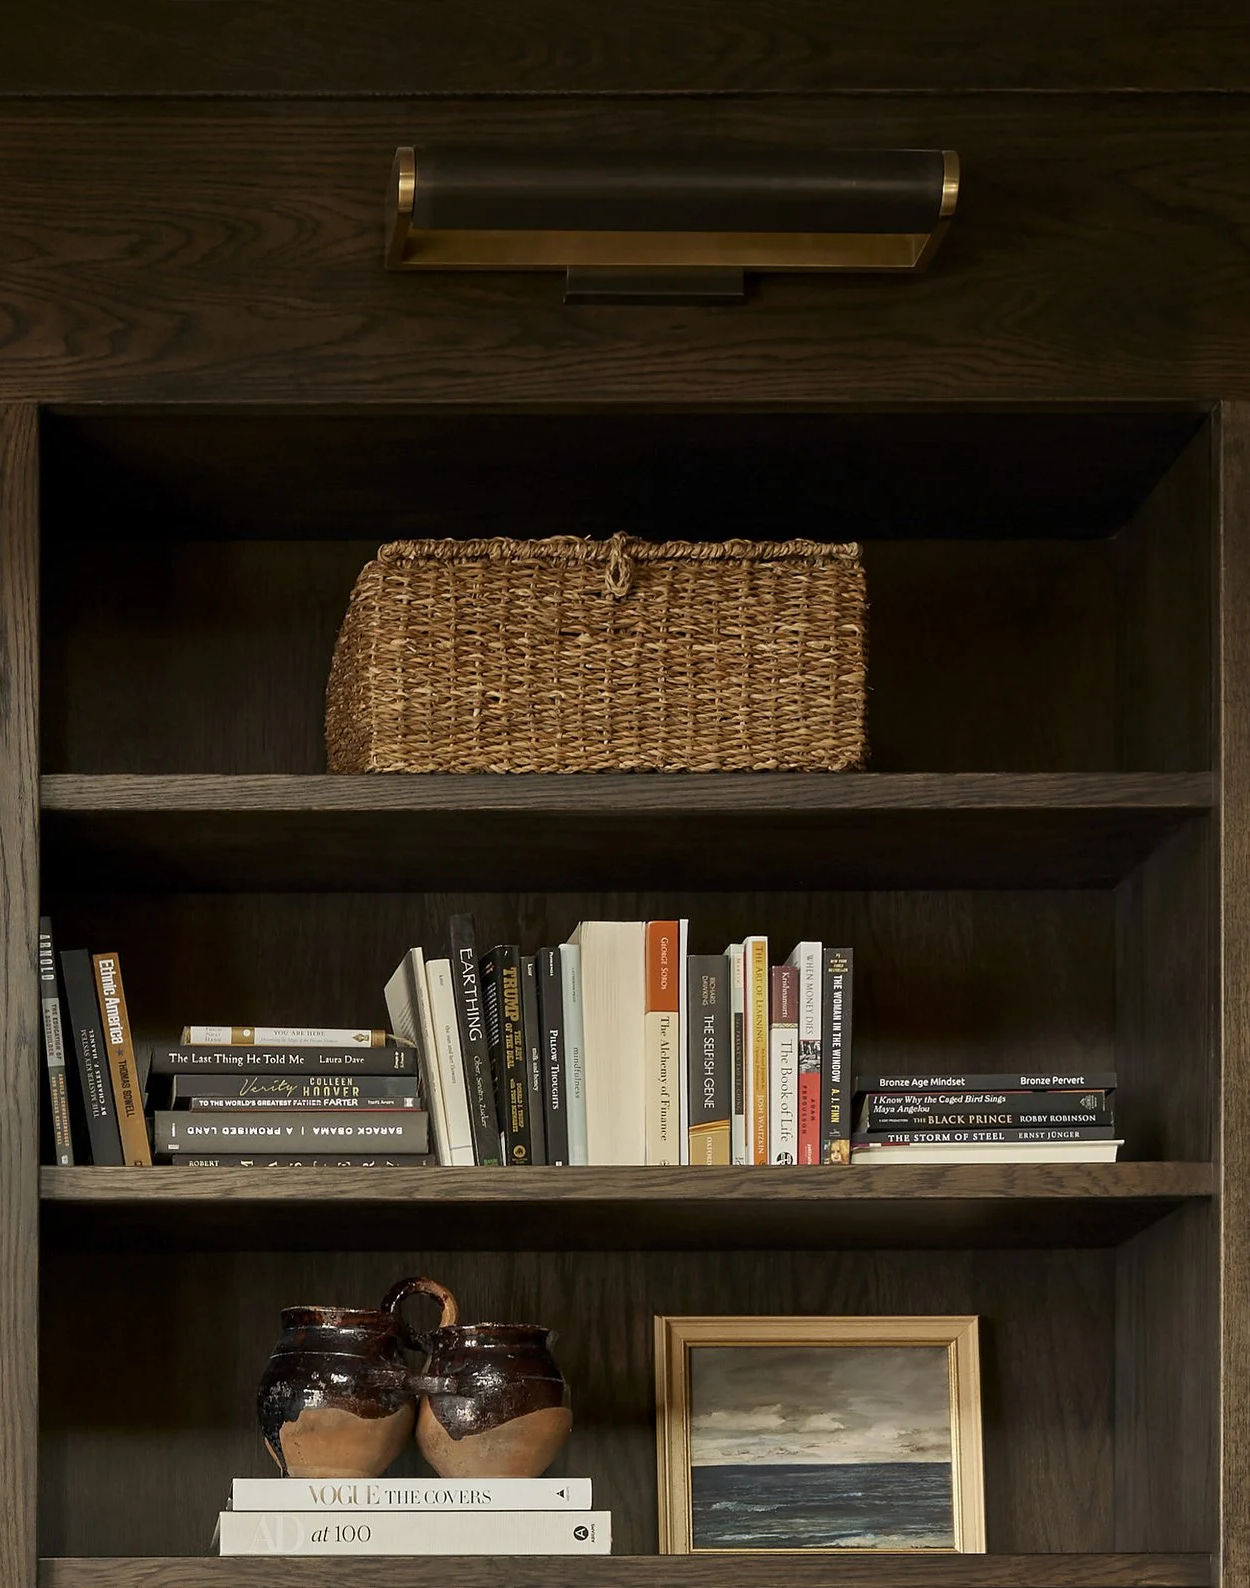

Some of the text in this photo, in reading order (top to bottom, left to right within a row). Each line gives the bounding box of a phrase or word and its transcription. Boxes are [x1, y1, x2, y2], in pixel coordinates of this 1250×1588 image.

[830, 974, 843, 990] THE
[98, 958, 124, 1046] Ethnic America
[459, 947, 484, 1042] EARTHING
[502, 966, 520, 1022] TRUMP
[830, 990, 843, 1021] WOMAN
[830, 1021, 843, 1032] IN
[830, 1032, 843, 1048] THE
[168, 1052, 305, 1067] The Last Thing He Told Me
[703, 1014, 716, 1109] THE SELFISH GENE
[830, 1048, 843, 1083] WINDOW
[308, 1077, 353, 1087] COLLEEN
[572, 1047, 582, 1100] mindfulness
[659, 1015, 671, 1142] The Alchemy of Finance
[879, 1077, 966, 1089] Bronze Age Mindset
[1019, 1076, 1085, 1086] Bronze Pervert
[238, 1076, 299, 1098] Verity
[780, 1038, 793, 1143] The Book of Life
[872, 1104, 931, 1115] Maya Angelou
[1019, 1114, 1097, 1123] ROBBY ROBINSON
[312, 1125, 404, 1136] BARACK OBAMA
[887, 1131, 1006, 1143] THE STORM OF STEEL
[307, 1483, 493, 1506] VOGUE THE COVERS
[310, 1524, 372, 1544] at 100
